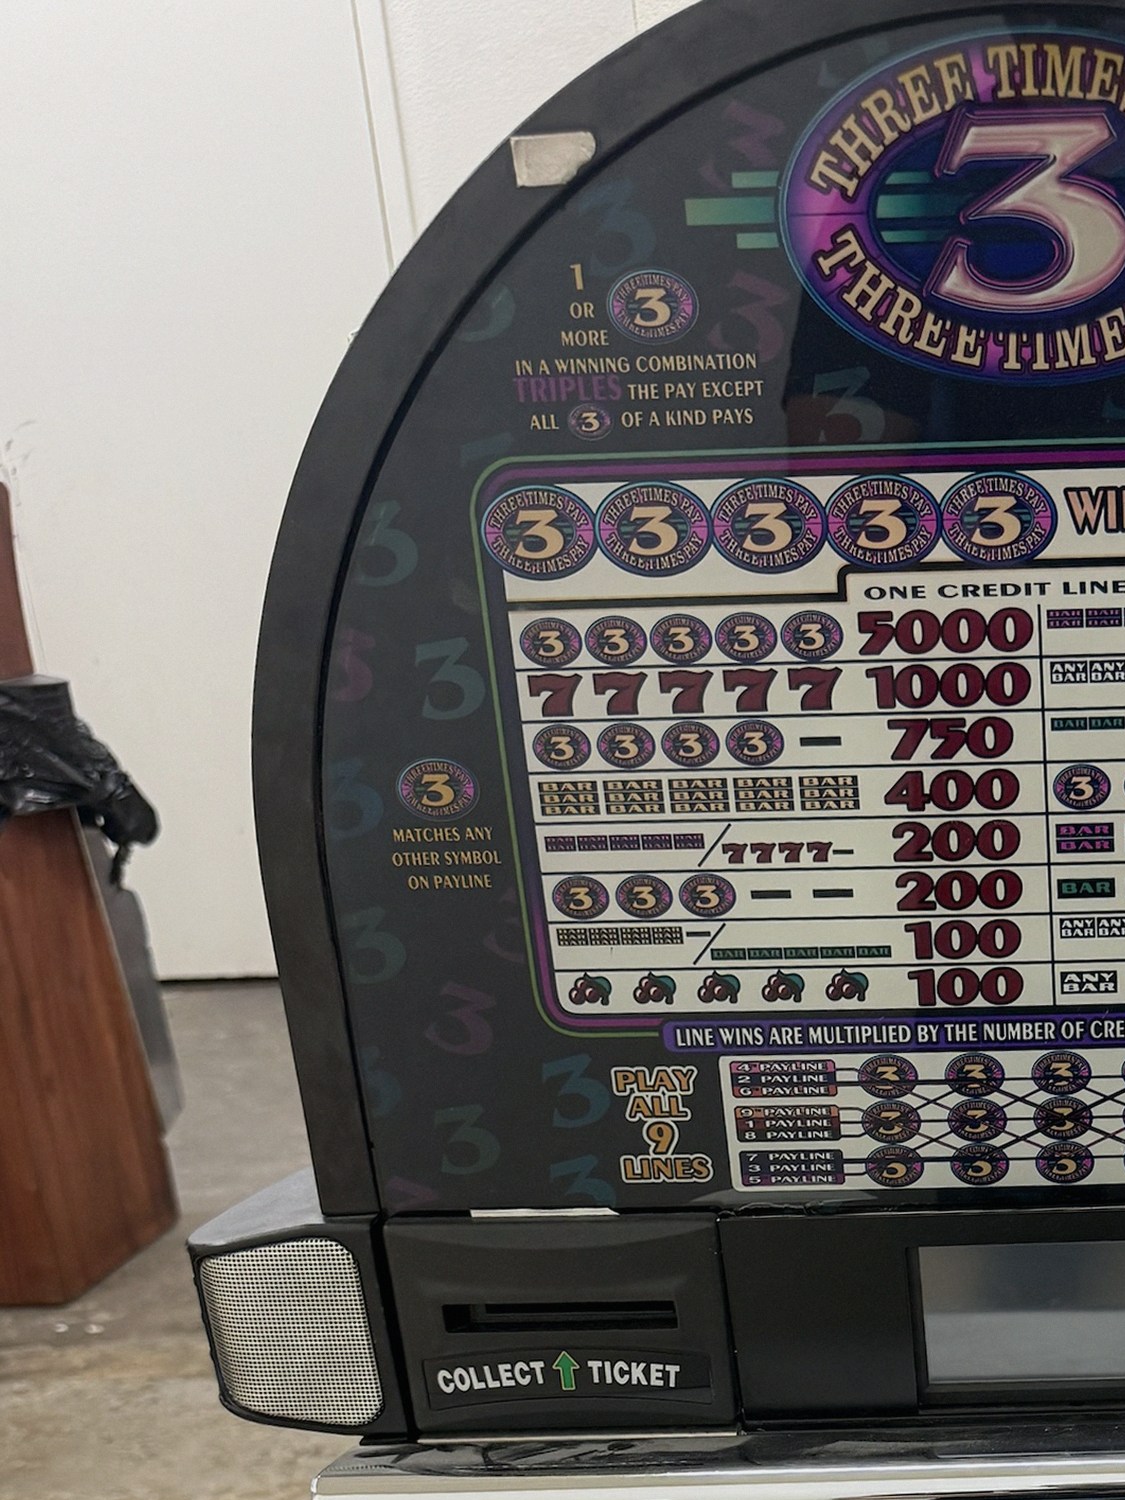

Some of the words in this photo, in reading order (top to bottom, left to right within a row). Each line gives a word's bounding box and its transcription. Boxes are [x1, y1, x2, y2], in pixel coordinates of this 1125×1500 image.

[809, 52, 976, 200] THREE
[570, 264, 584, 290] 1
[570, 302, 595, 319] OR
[816, 228, 985, 371] THREE
[561, 330, 610, 347] MORE
[515, 359, 533, 376] IN
[539, 359, 551, 375] A
[554, 356, 630, 375] WINNING
[636, 352, 757, 373] COMBINATION
[513, 374, 622, 403] TRIPLES
[627, 383, 660, 400] THE
[664, 382, 697, 399] PAY
[702, 380, 764, 398] EXCEPT
[530, 414, 559, 430] ALL
[621, 411, 644, 428] OF
[649, 411, 661, 427] A
[666, 410, 707, 427] KIND
[712, 408, 754, 425] PAYS
[864, 584, 927, 600] ONE
[937, 581, 1052, 598] CREDIT
[857, 606, 1034, 656] 5000
[865, 661, 1032, 711] 1000
[884, 716, 1014, 761] 750
[885, 768, 1020, 812] 400
[392, 827, 461, 843] MATCHES
[465, 827, 493, 841] ANY
[892, 820, 1020, 863] 200
[392, 852, 440, 867] OTHER
[444, 850, 502, 865] SYMBOL
[408, 875, 430, 890] ON
[434, 874, 493, 889] PAYLINE
[896, 869, 1023, 912] 200
[904, 918, 1021, 960] 100
[908, 966, 1024, 1007] 100
[675, 1027, 716, 1048] LINE
[718, 1026, 764, 1047] WINS
[769, 1025, 803, 1045] ARE
[808, 1023, 912, 1045] MULTIPLIED
[916, 1023, 941, 1043] BY
[943, 1023, 978, 1042] THE
[983, 1021, 1056, 1042] NUMBER
[1060, 1019, 1085, 1039] OF
[613, 1067, 695, 1094] PLAY
[629, 1095, 688, 1118] ALL
[647, 1121, 675, 1154] 9
[623, 1156, 711, 1180] LINES
[437, 1361, 545, 1395] COLLECT
[587, 1359, 680, 1389] TICKET
